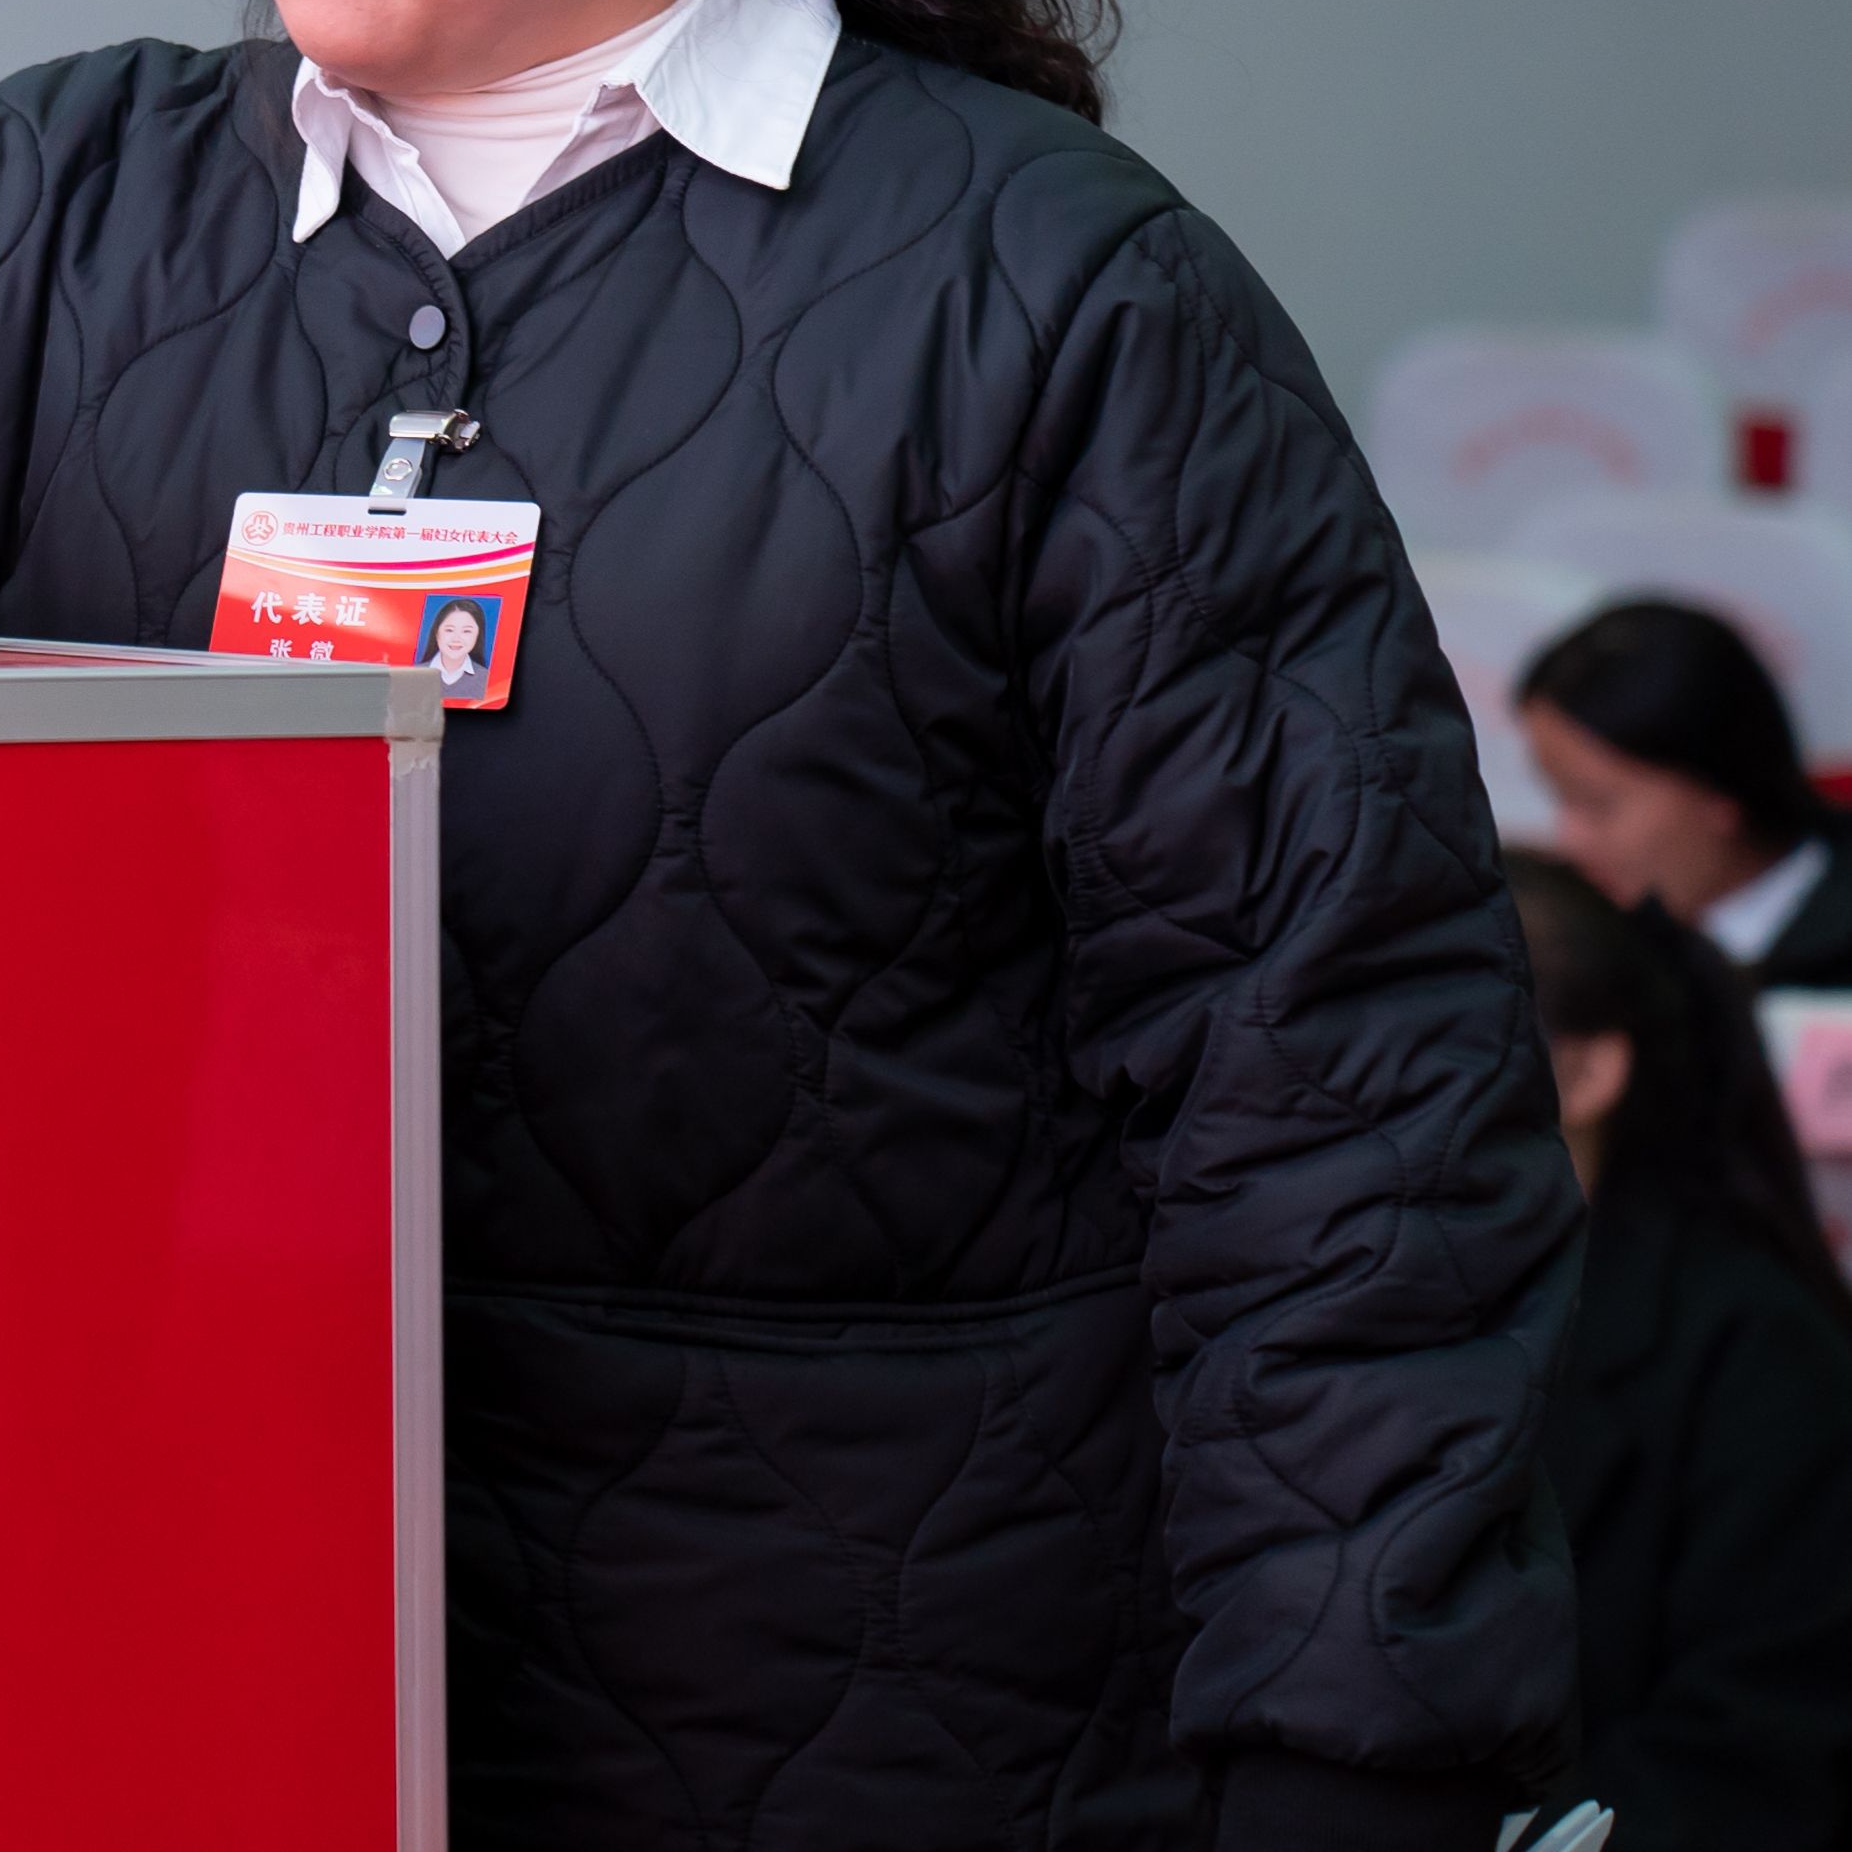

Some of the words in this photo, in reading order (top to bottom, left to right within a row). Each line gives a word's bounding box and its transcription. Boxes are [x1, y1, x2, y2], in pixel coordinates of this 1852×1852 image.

[282, 521, 519, 545] 贵州工程职业学院第一届妇女代表大会
[251, 591, 369, 627] 代表证
